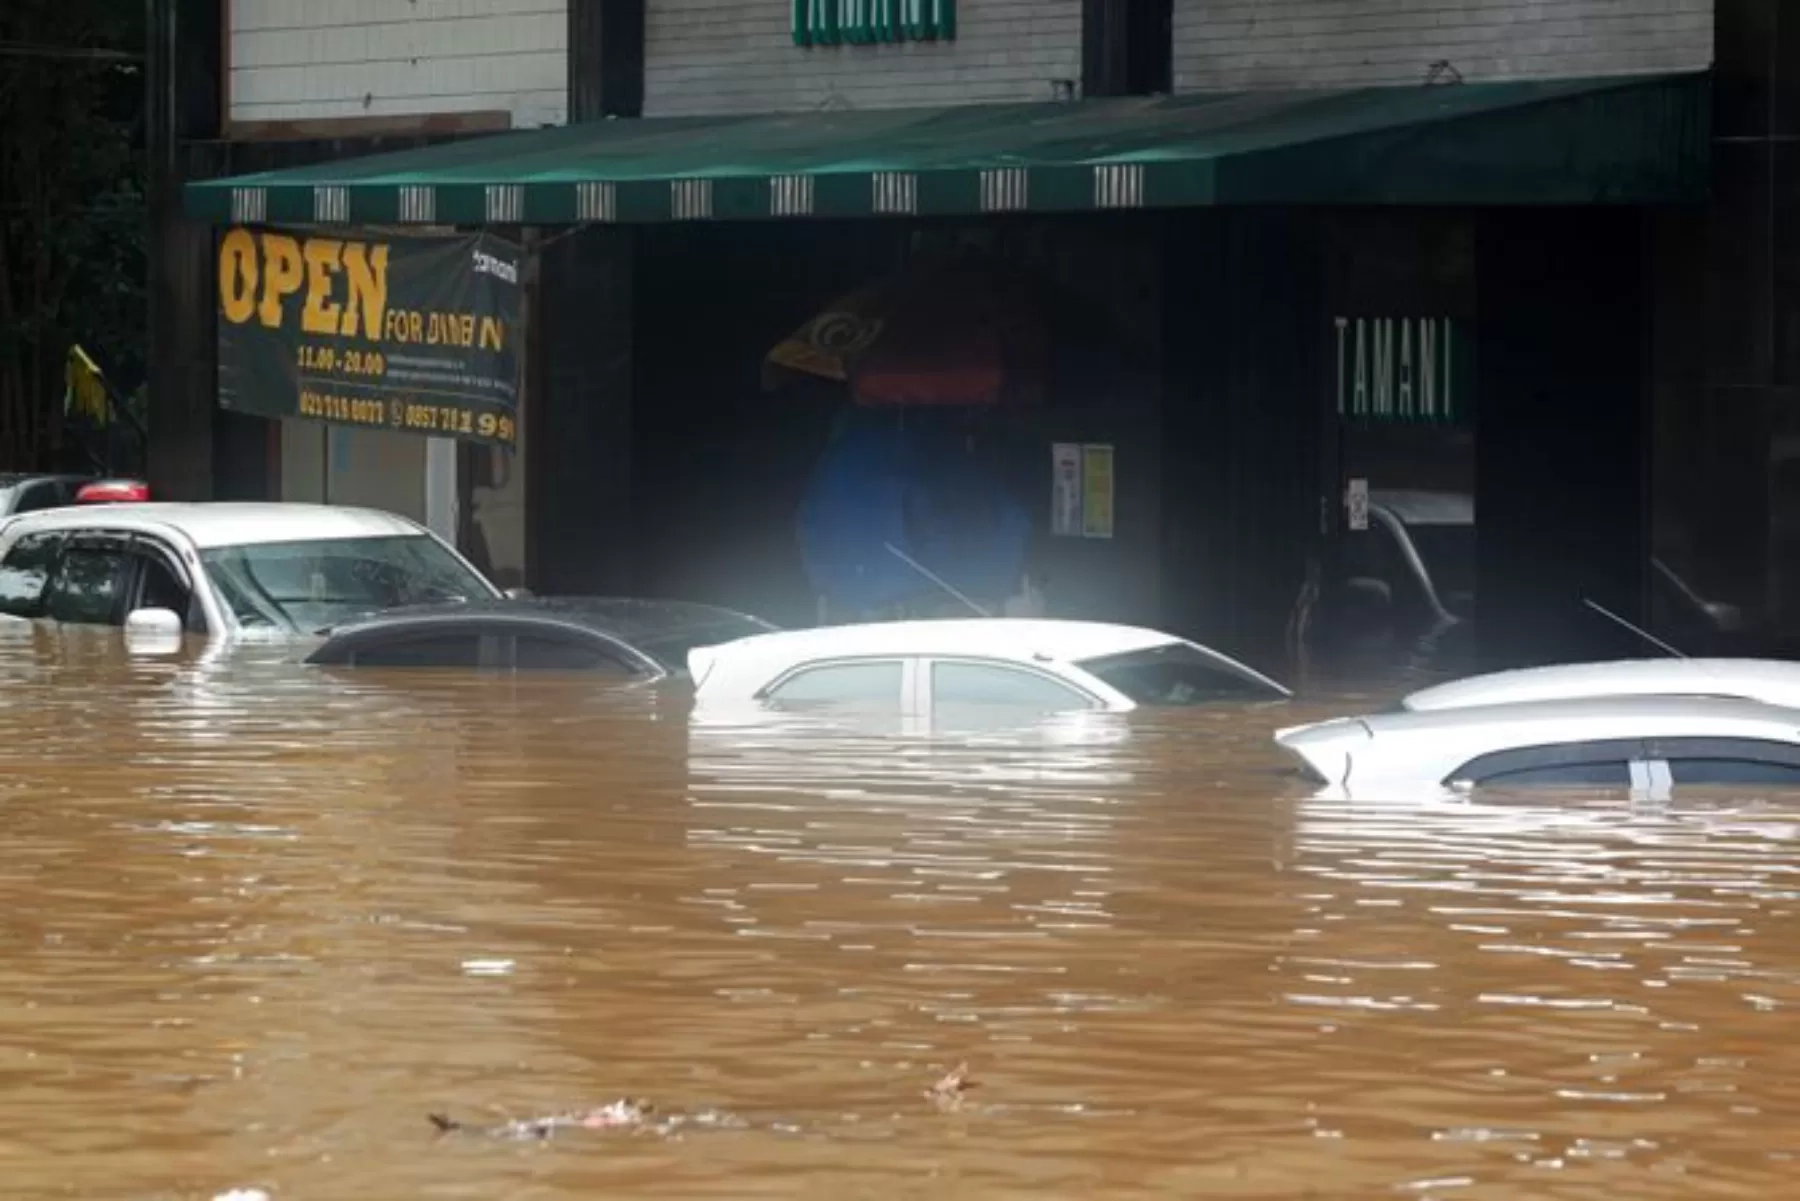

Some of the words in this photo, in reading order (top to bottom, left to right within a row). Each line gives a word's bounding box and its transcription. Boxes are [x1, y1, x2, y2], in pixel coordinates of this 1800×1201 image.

[219, 228, 389, 341] OPEN
[385, 308, 422, 342] FOR
[1334, 316, 1452, 416] TAMANI
